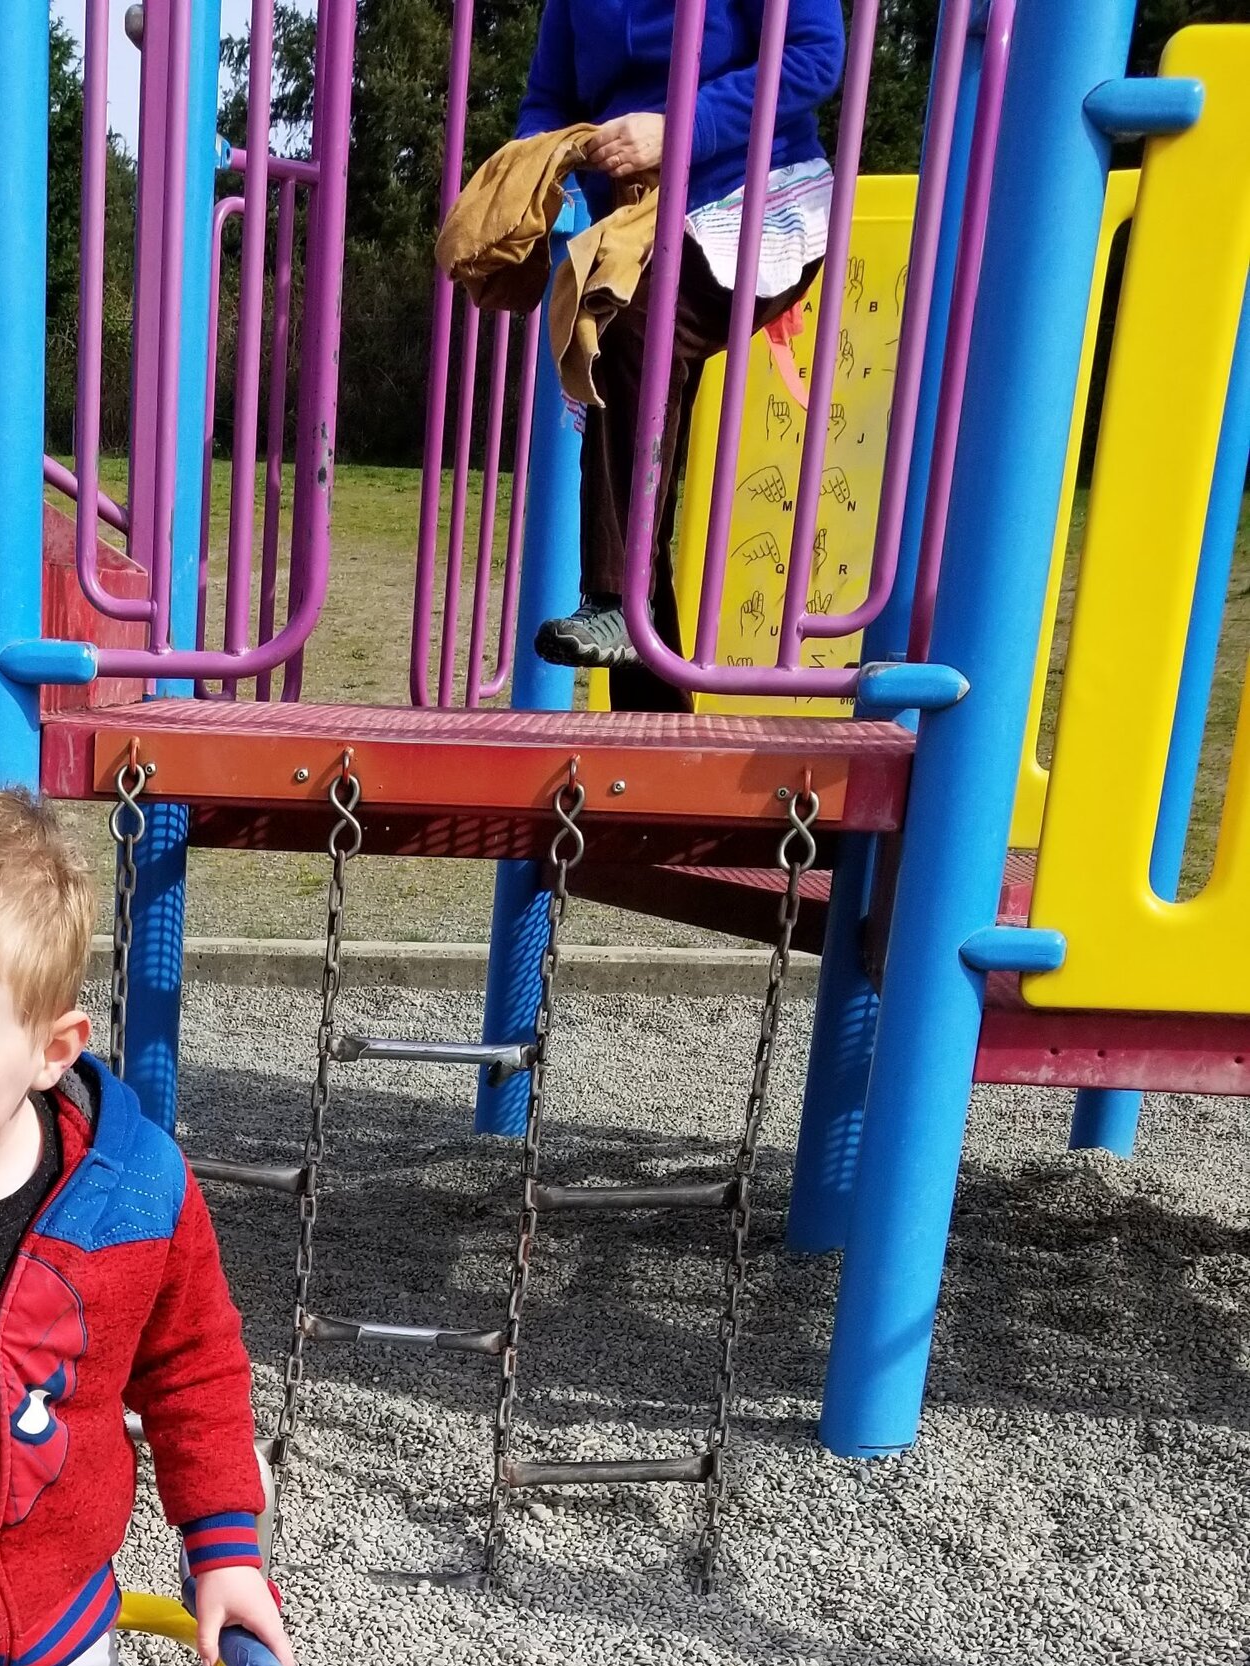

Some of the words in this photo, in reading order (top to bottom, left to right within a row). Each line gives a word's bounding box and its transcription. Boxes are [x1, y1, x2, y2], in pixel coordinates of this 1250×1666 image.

[803, 301, 813, 313] A
[869, 301, 878, 313] B
[798, 367, 807, 379] E
[863, 367, 872, 379] F
[857, 433, 865, 444] J
[783, 501, 792, 511] M
[847, 501, 856, 511] N
[775, 563, 785, 575] Q
[839, 564, 848, 575] R
[770, 626, 779, 637] U
